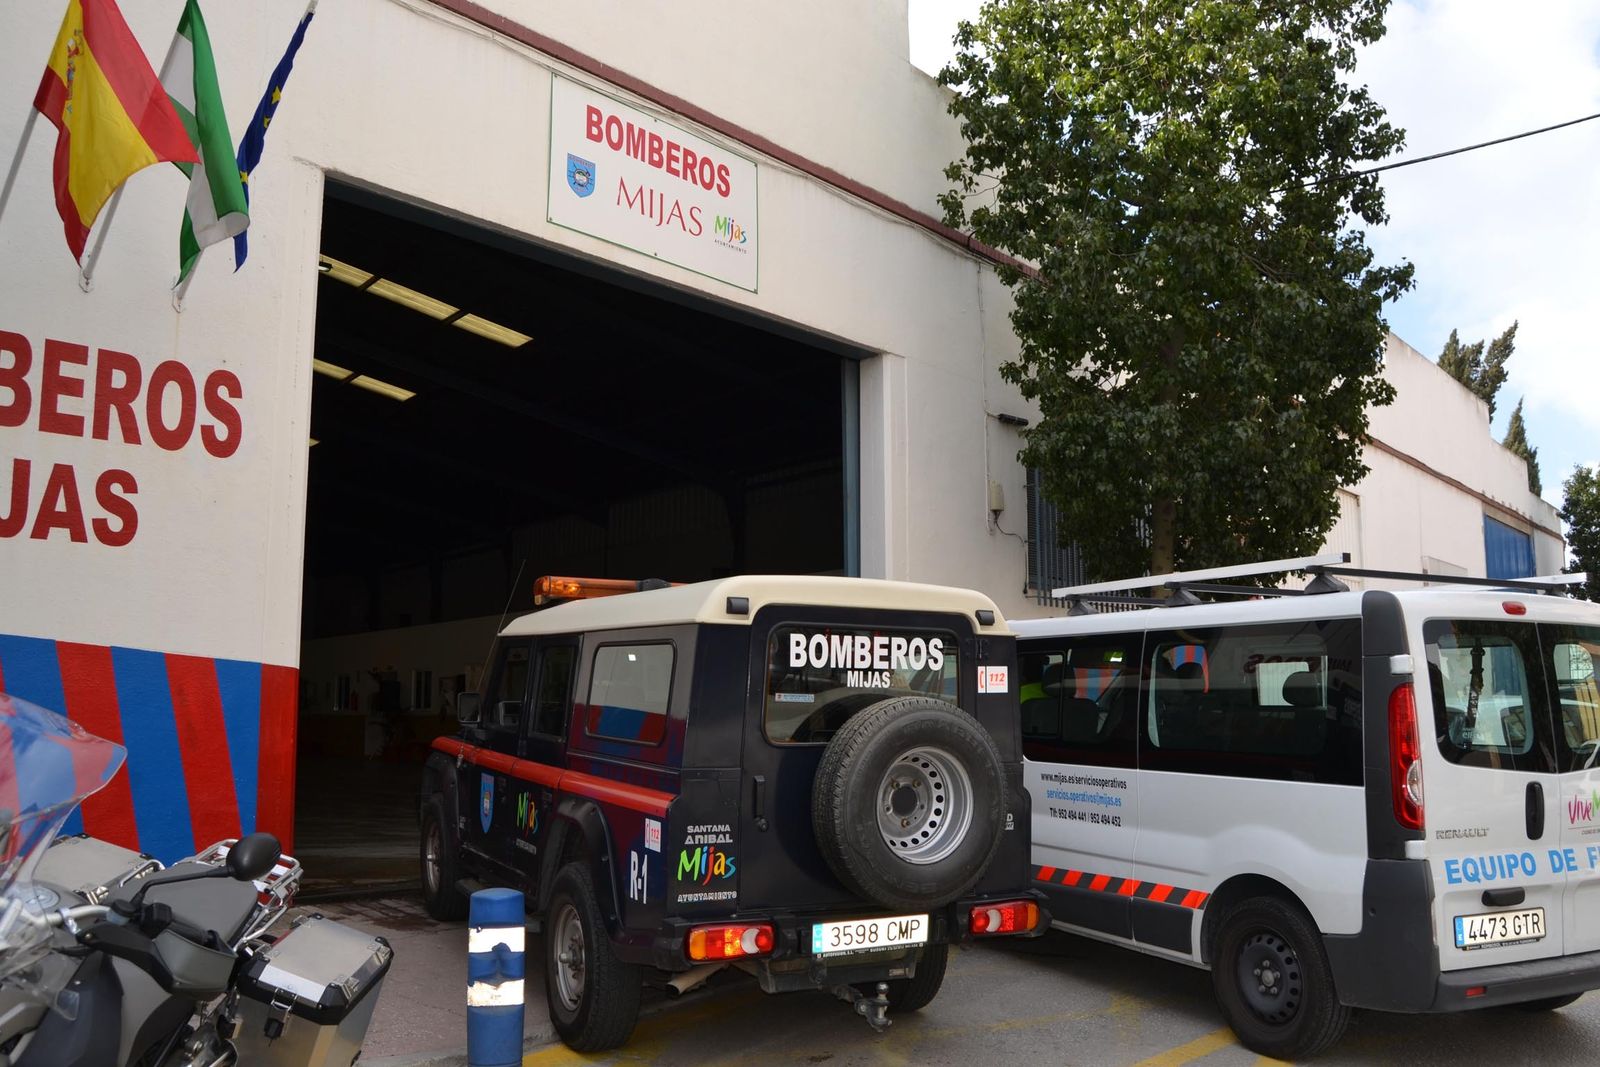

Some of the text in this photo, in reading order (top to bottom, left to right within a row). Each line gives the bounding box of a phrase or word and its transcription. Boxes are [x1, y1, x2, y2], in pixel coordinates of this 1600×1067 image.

[586, 104, 731, 198] BOMBEROS
[616, 176, 702, 236] MIJAS
[714, 215, 747, 244] Mijas
[0, 330, 243, 459] BEROS
[789, 633, 944, 671] BOMBEROS
[846, 671, 891, 688] MIJAS
[990, 672, 1005, 682] 112
[687, 824, 731, 834] SANTANA
[1058, 808, 1067, 819] 952
[1068, 810, 1077, 820] 494
[1078, 811, 1087, 822] 441
[1090, 812, 1100, 824] 952
[1100, 814, 1110, 825] 494
[1111, 816, 1121, 827] 452
[650, 828, 659, 840] 112
[684, 834, 733, 844] ANIBAL
[1435, 828, 1489, 840] RENAULT
[630, 850, 648, 904] R-1
[677, 845, 737, 886] Mijas
[1444, 846, 1600, 884] EQUIPO DE F
[677, 891, 737, 902] AYUNTAMIENTO
[830, 919, 920, 947] 3598 CMP
[1469, 913, 1541, 941] 4473 GTR
